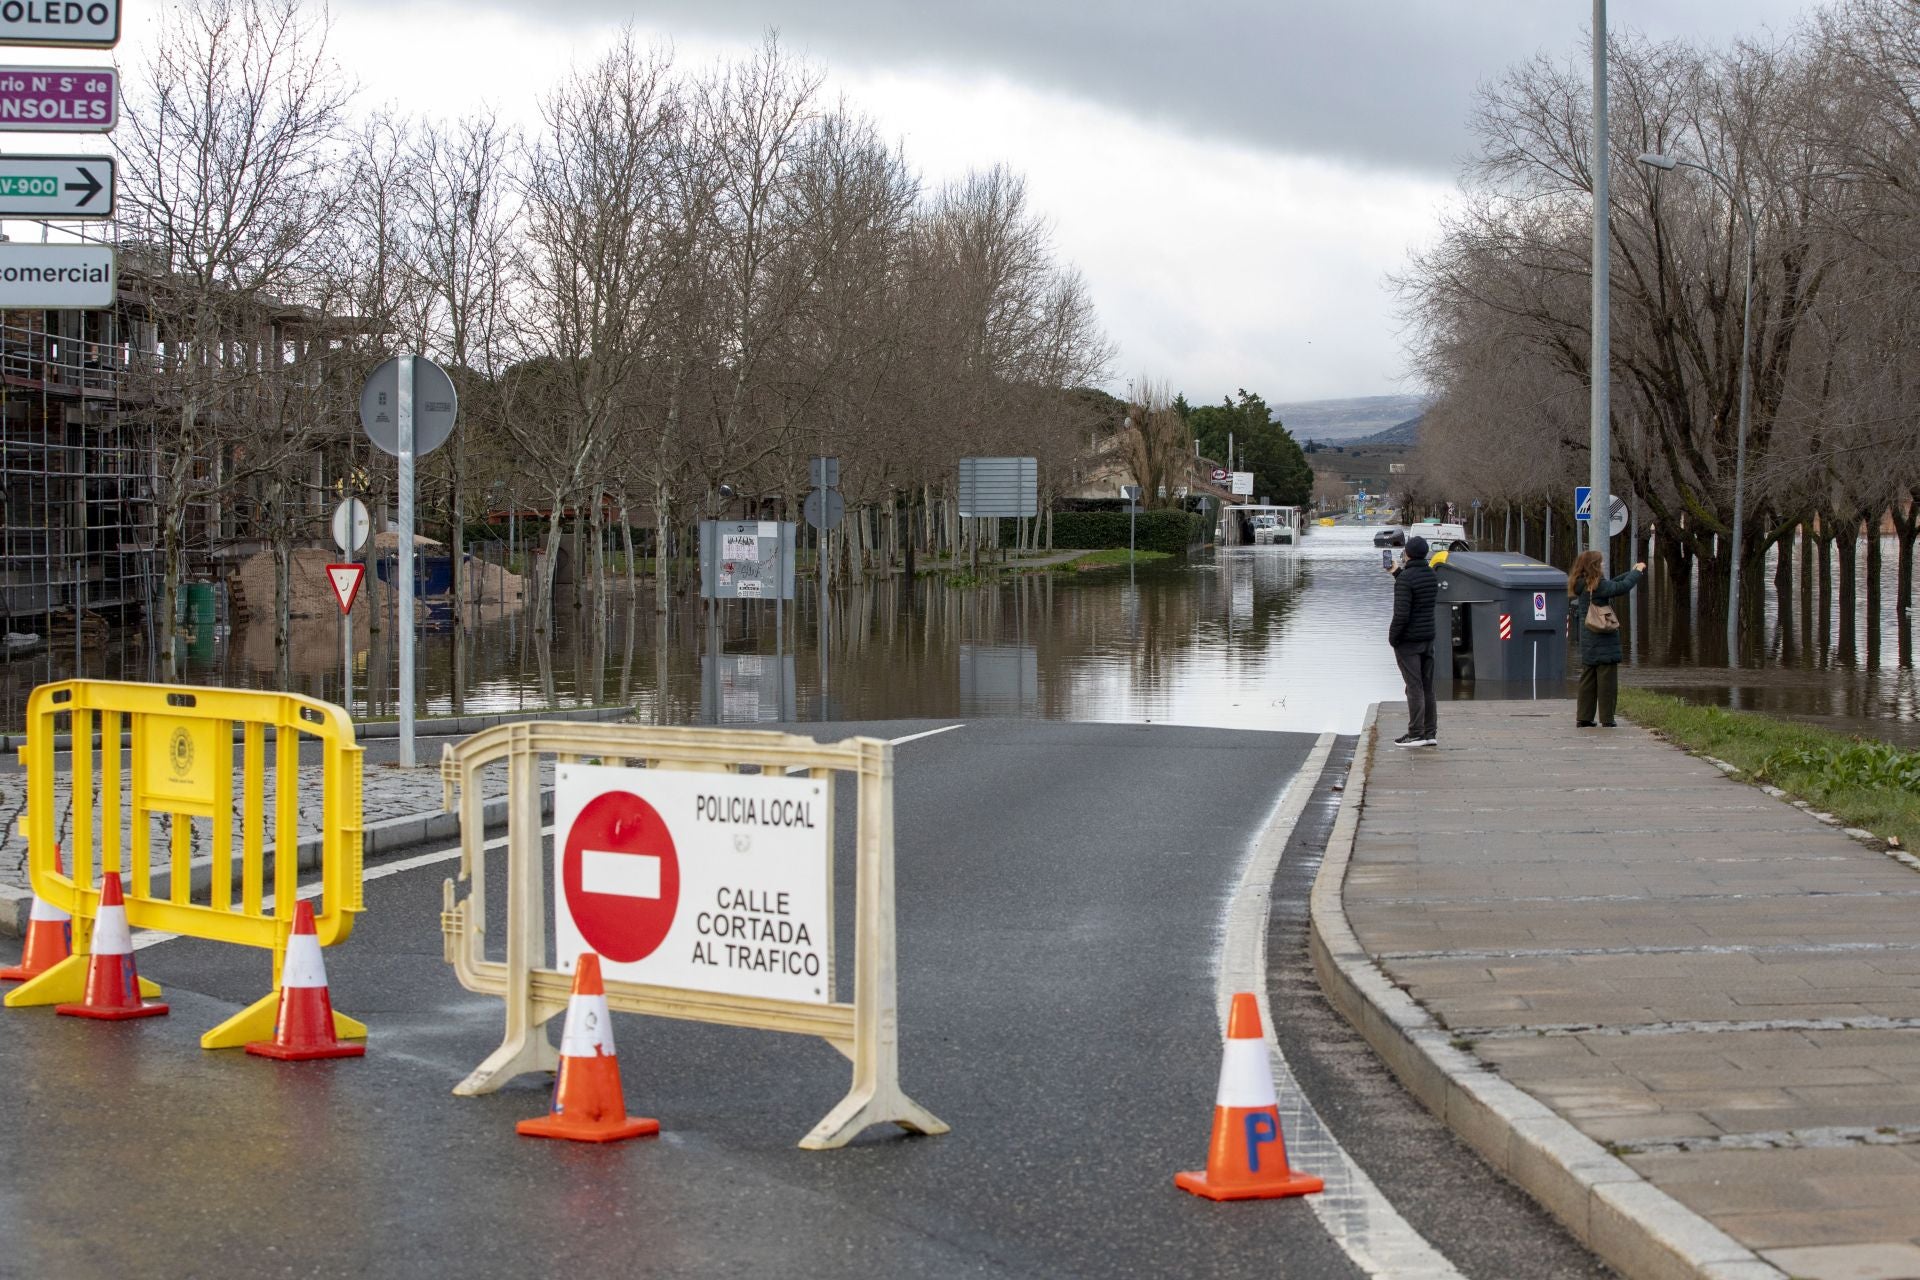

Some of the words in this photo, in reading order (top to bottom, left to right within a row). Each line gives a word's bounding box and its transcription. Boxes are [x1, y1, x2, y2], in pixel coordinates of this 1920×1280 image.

[0, 0, 109, 25] OLEDO
[84, 79, 107, 93] de
[0, 98, 107, 120] NSOLES
[0, 178, 56, 194] V-900
[0, 263, 109, 283] omercial
[697, 796, 756, 824] POLICIA
[762, 800, 814, 828] LOCAL
[717, 887, 789, 915] CALLE
[697, 913, 811, 946] CORTADA
[692, 941, 718, 966] AL
[726, 944, 819, 976] TRAFICO
[1245, 1113, 1276, 1172] P
